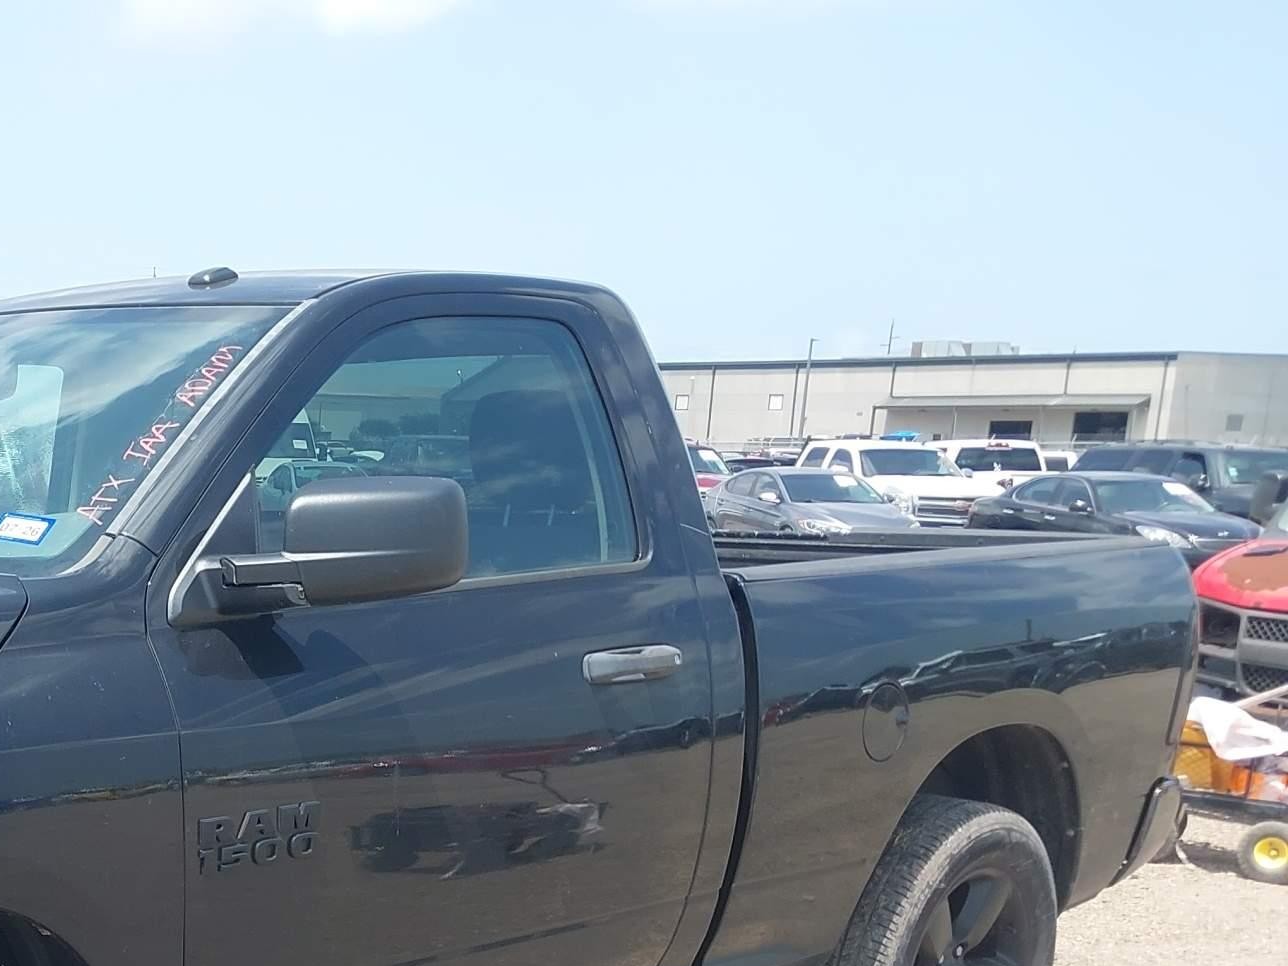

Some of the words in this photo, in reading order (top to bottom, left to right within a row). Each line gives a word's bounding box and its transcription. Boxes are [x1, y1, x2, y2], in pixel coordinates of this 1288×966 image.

[76, 474, 136, 527] ATX
[122, 419, 181, 466] IAA
[197, 800, 321, 847] RAM
[198, 830, 321, 875] 1500
